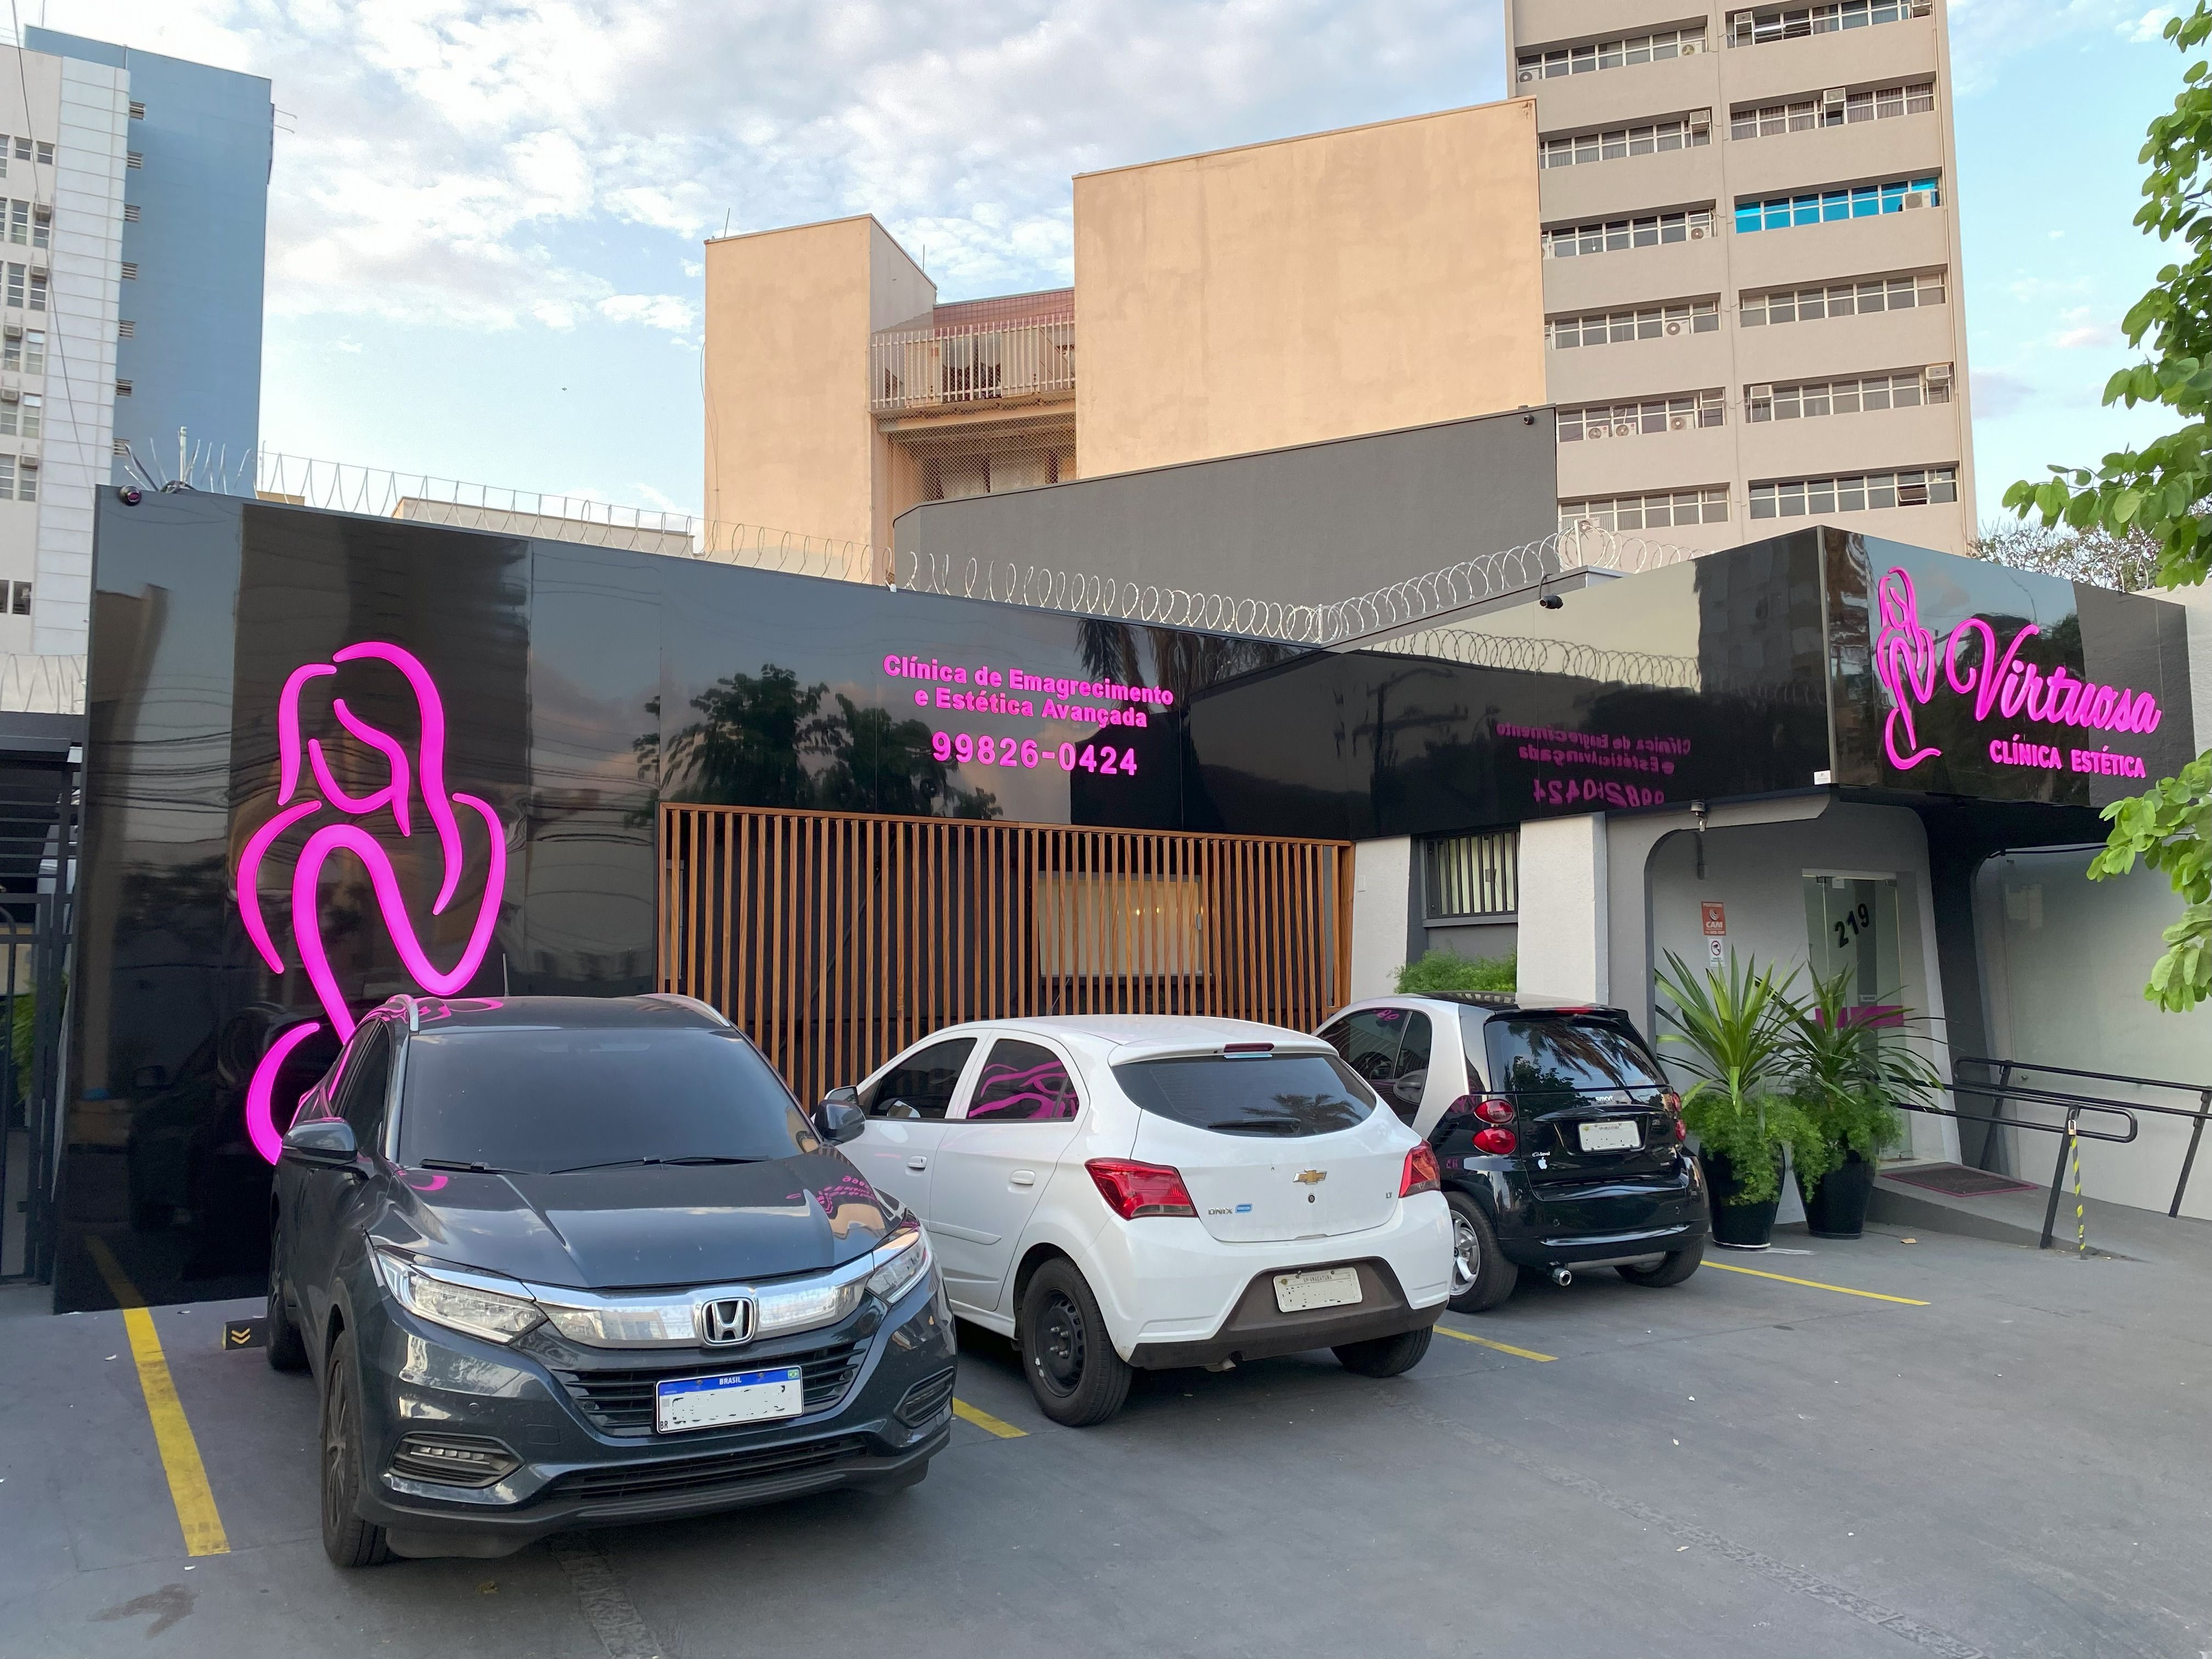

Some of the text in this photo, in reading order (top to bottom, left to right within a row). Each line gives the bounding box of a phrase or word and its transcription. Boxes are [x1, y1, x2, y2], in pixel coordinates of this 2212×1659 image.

[883, 654, 1174, 705] Clínica de Emagrecimento
[1944, 618, 2163, 734] Virtuosa
[914, 687, 1147, 729] e Estética Avançada
[932, 731, 1137, 776] 99826-0424
[1989, 733, 2147, 778] CLÍNICA ESTÉTICA
[1835, 903, 1870, 949] 219
[719, 1376, 742, 1385] BRASIL
[660, 1420, 668, 1430] BR
